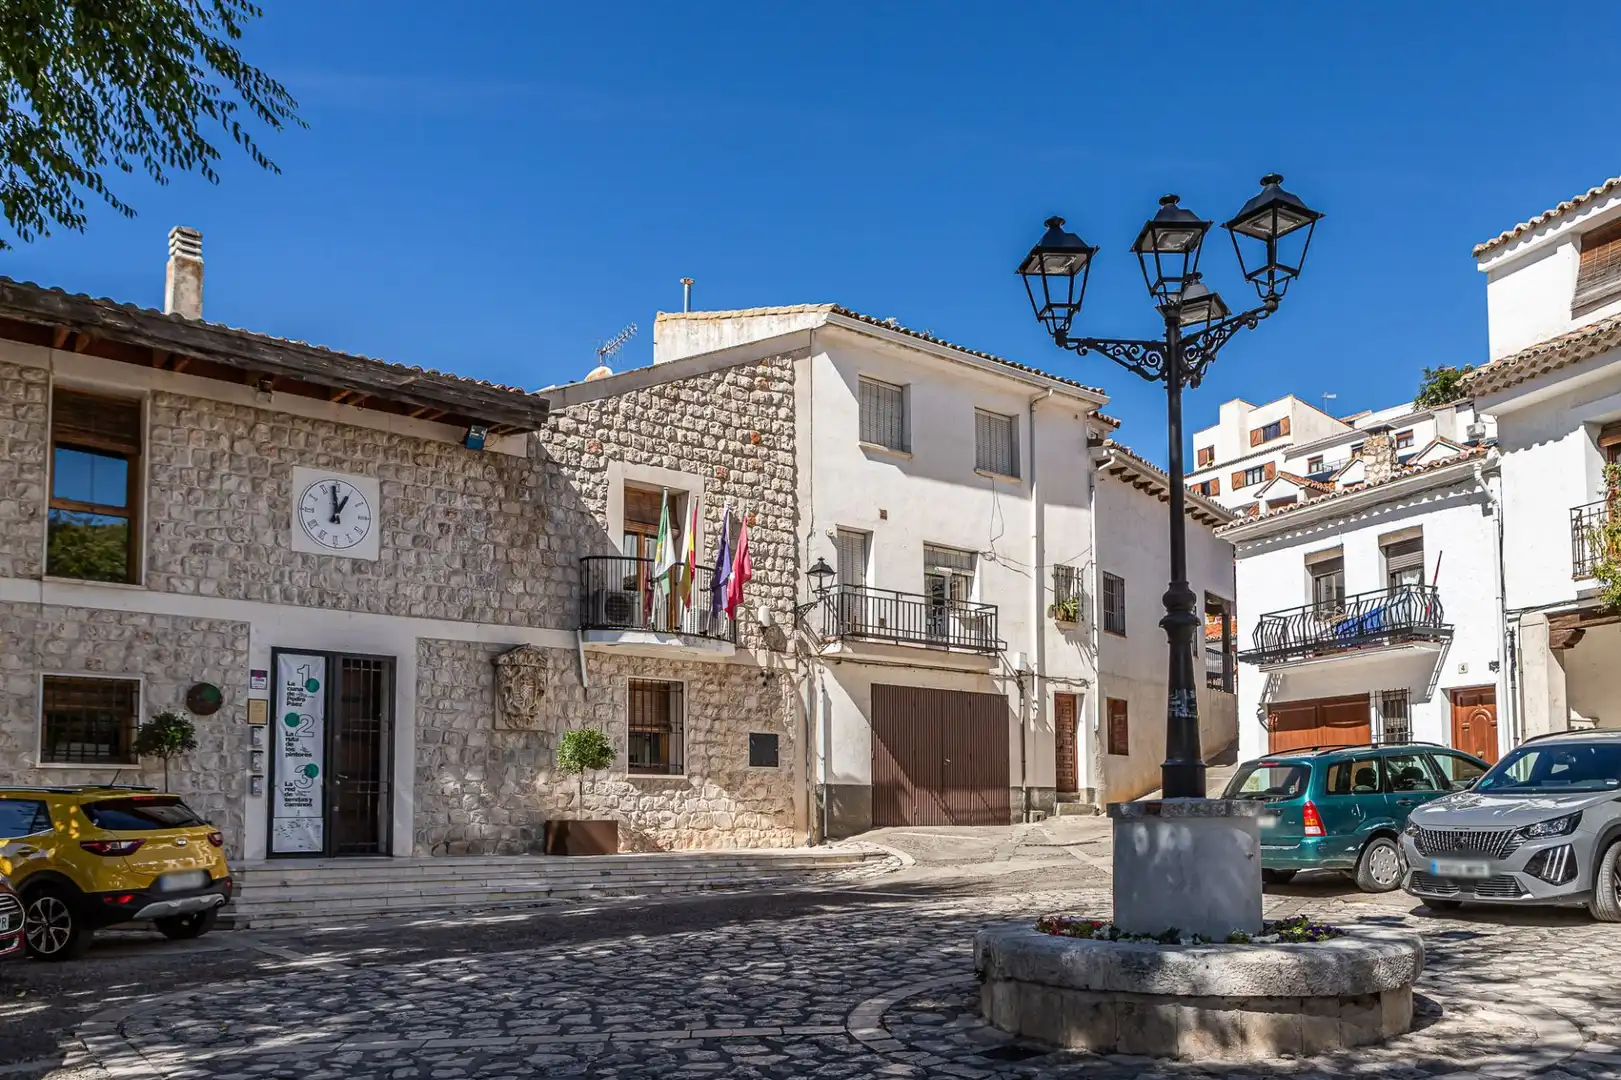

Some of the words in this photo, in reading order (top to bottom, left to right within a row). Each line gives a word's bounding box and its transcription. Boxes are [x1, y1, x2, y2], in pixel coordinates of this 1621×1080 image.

[297, 663, 311, 688] 1
[295, 713, 315, 738] 2
[294, 764, 314, 789] 3
